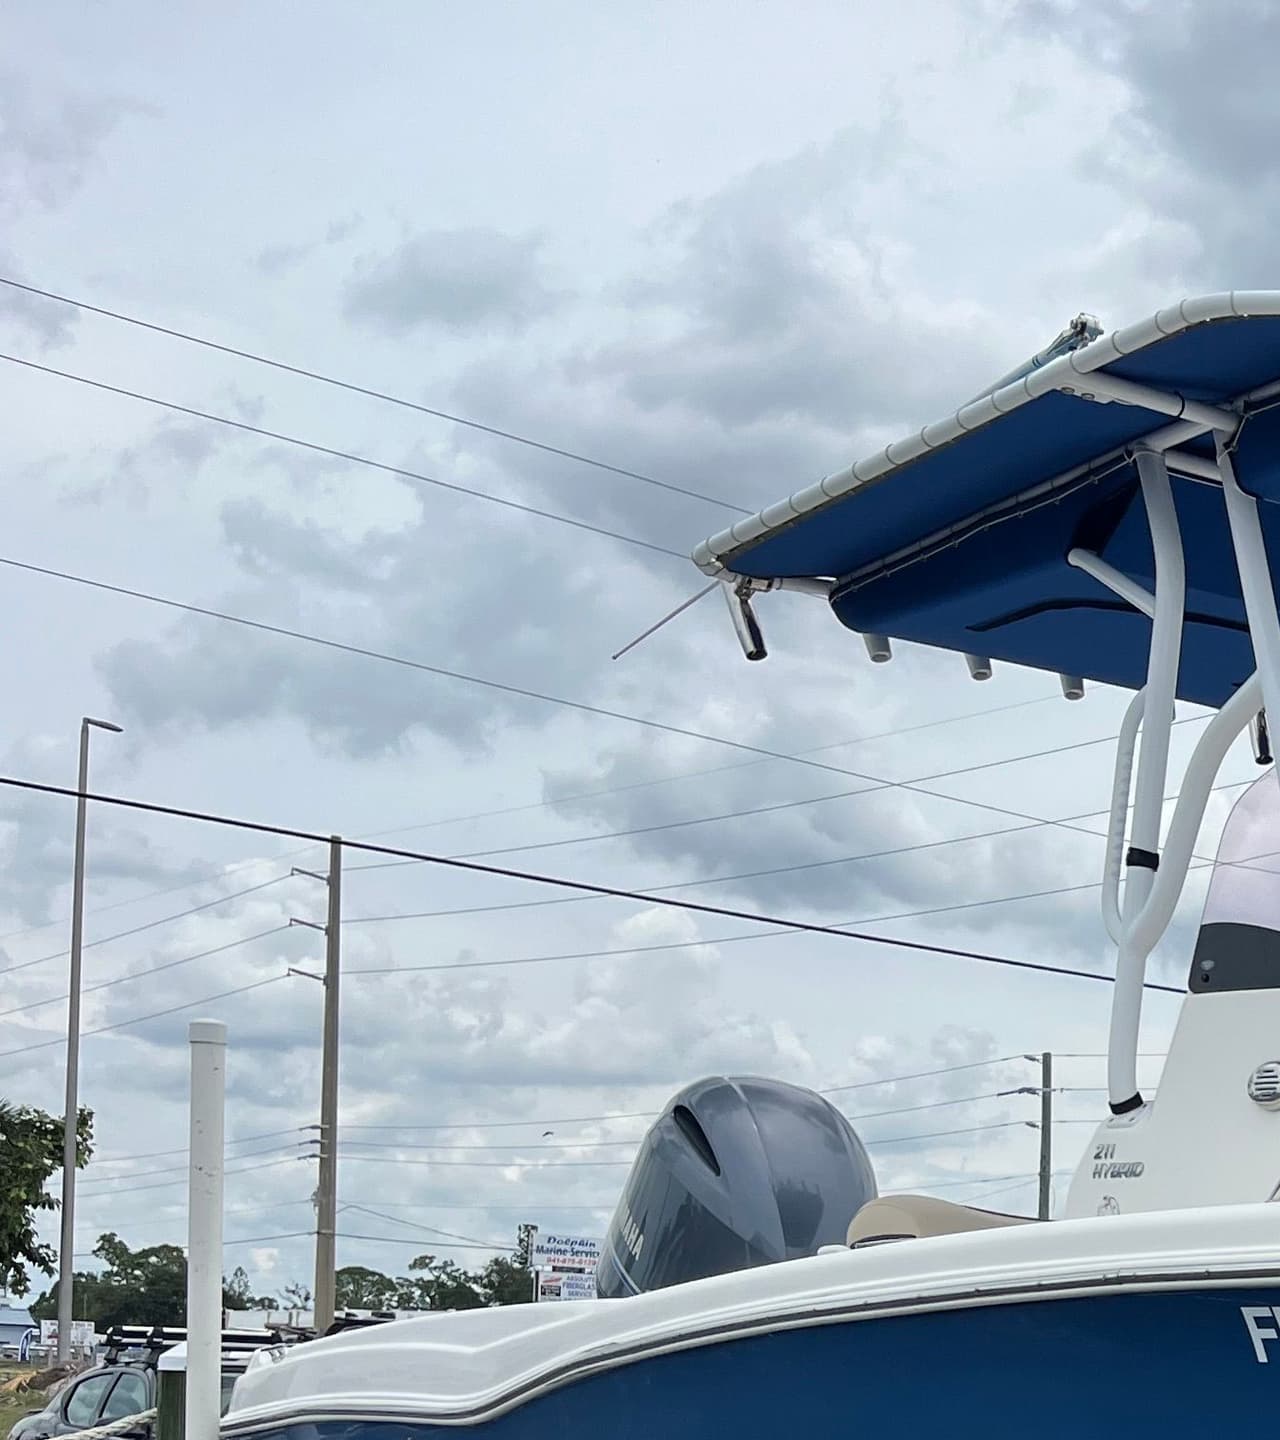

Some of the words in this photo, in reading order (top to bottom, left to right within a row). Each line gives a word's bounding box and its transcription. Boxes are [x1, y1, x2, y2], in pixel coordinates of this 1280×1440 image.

[1094, 1144, 1116, 1160] 211
[1093, 1162, 1144, 1179] HYBRID
[547, 1236, 596, 1248] Dolphin
[536, 1245, 567, 1257] Marine
